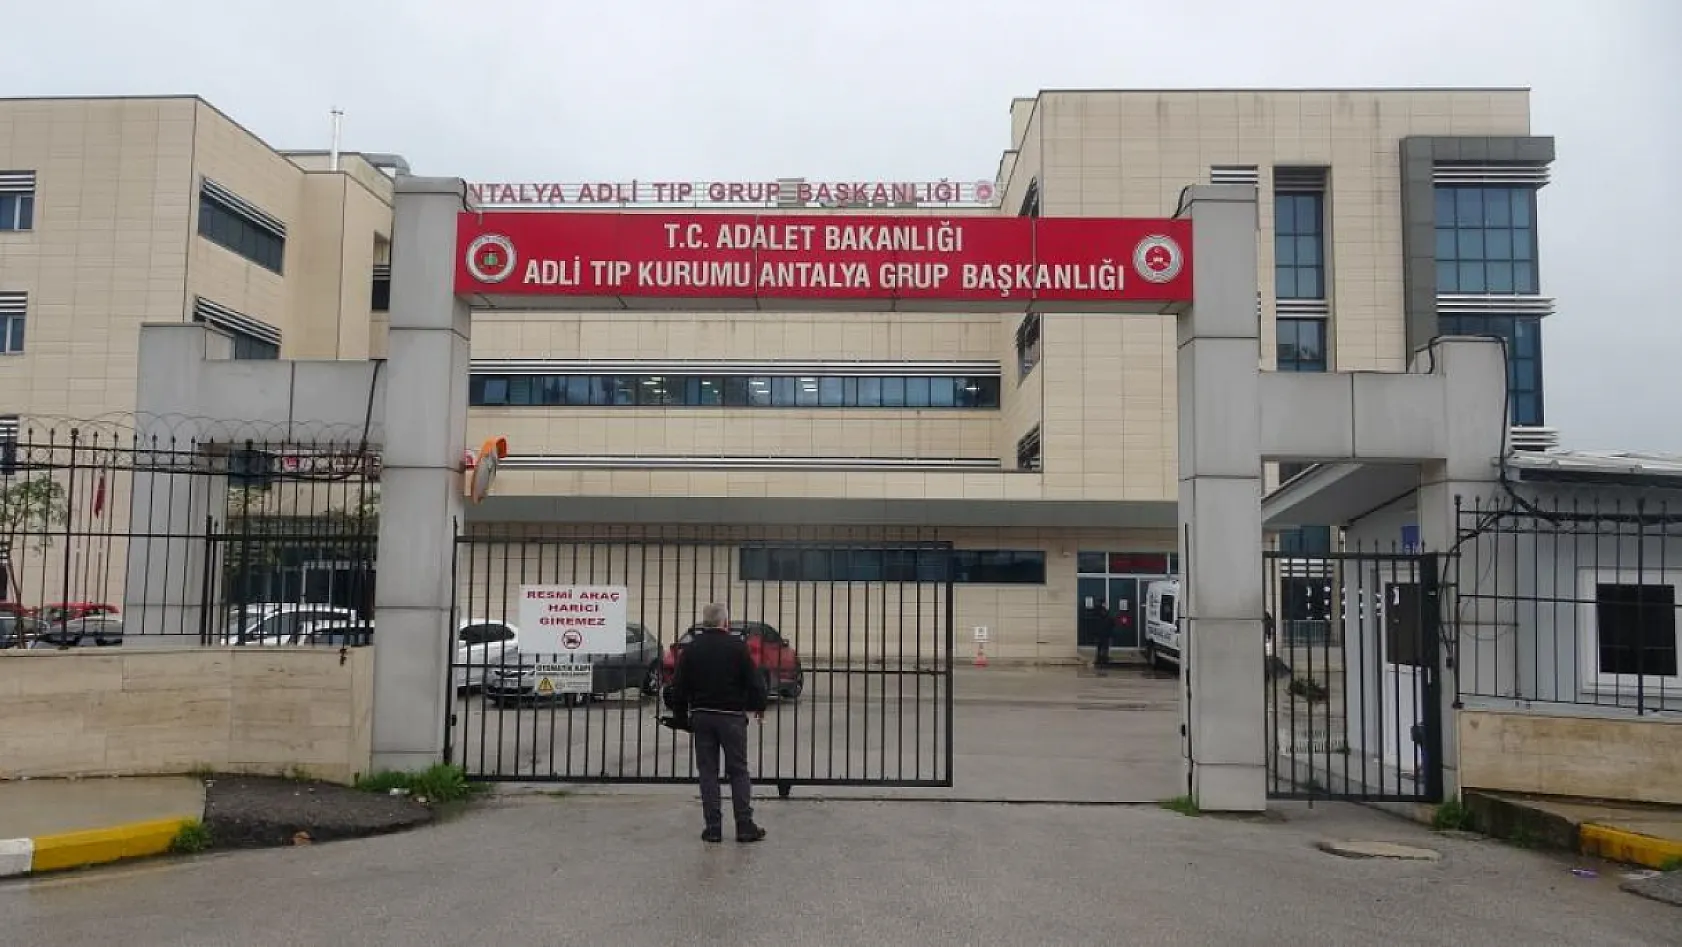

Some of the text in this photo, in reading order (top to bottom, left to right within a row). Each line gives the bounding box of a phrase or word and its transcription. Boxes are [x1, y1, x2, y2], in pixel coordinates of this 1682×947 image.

[465, 184, 566, 203] NTALYA
[578, 179, 637, 203] ADLİ
[652, 183, 693, 203] TIP
[708, 182, 781, 203] GRUP
[664, 221, 963, 252] T.C. ADALET BAKANLIĞI
[523, 255, 1125, 296] ADLİ TIP KURUMU ANTALYA GRUP BAŞKANLIĞI
[526, 589, 620, 602] RESMİ ARAÇ
